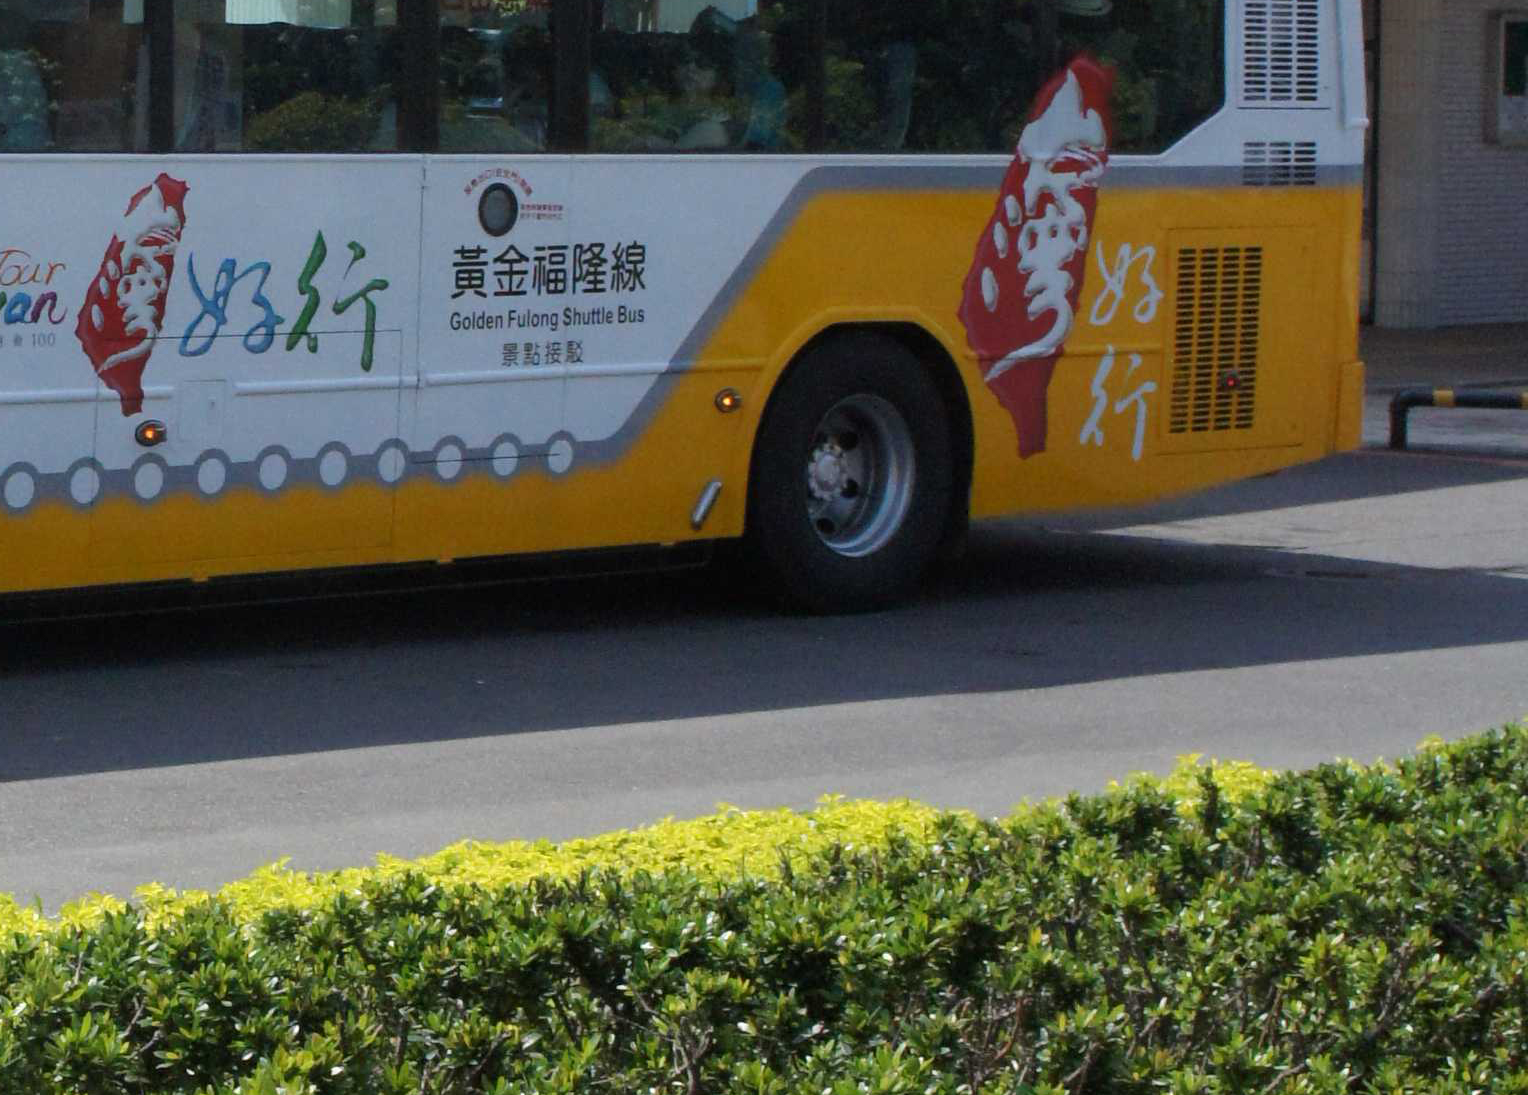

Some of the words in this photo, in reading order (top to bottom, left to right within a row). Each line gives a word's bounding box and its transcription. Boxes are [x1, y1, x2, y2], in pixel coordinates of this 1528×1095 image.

[451, 241, 646, 299] 黃金福隆線
[450, 310, 503, 331] Golden
[507, 309, 558, 332] Fulong
[562, 306, 613, 327] Shuttle
[617, 305, 645, 324] Bus
